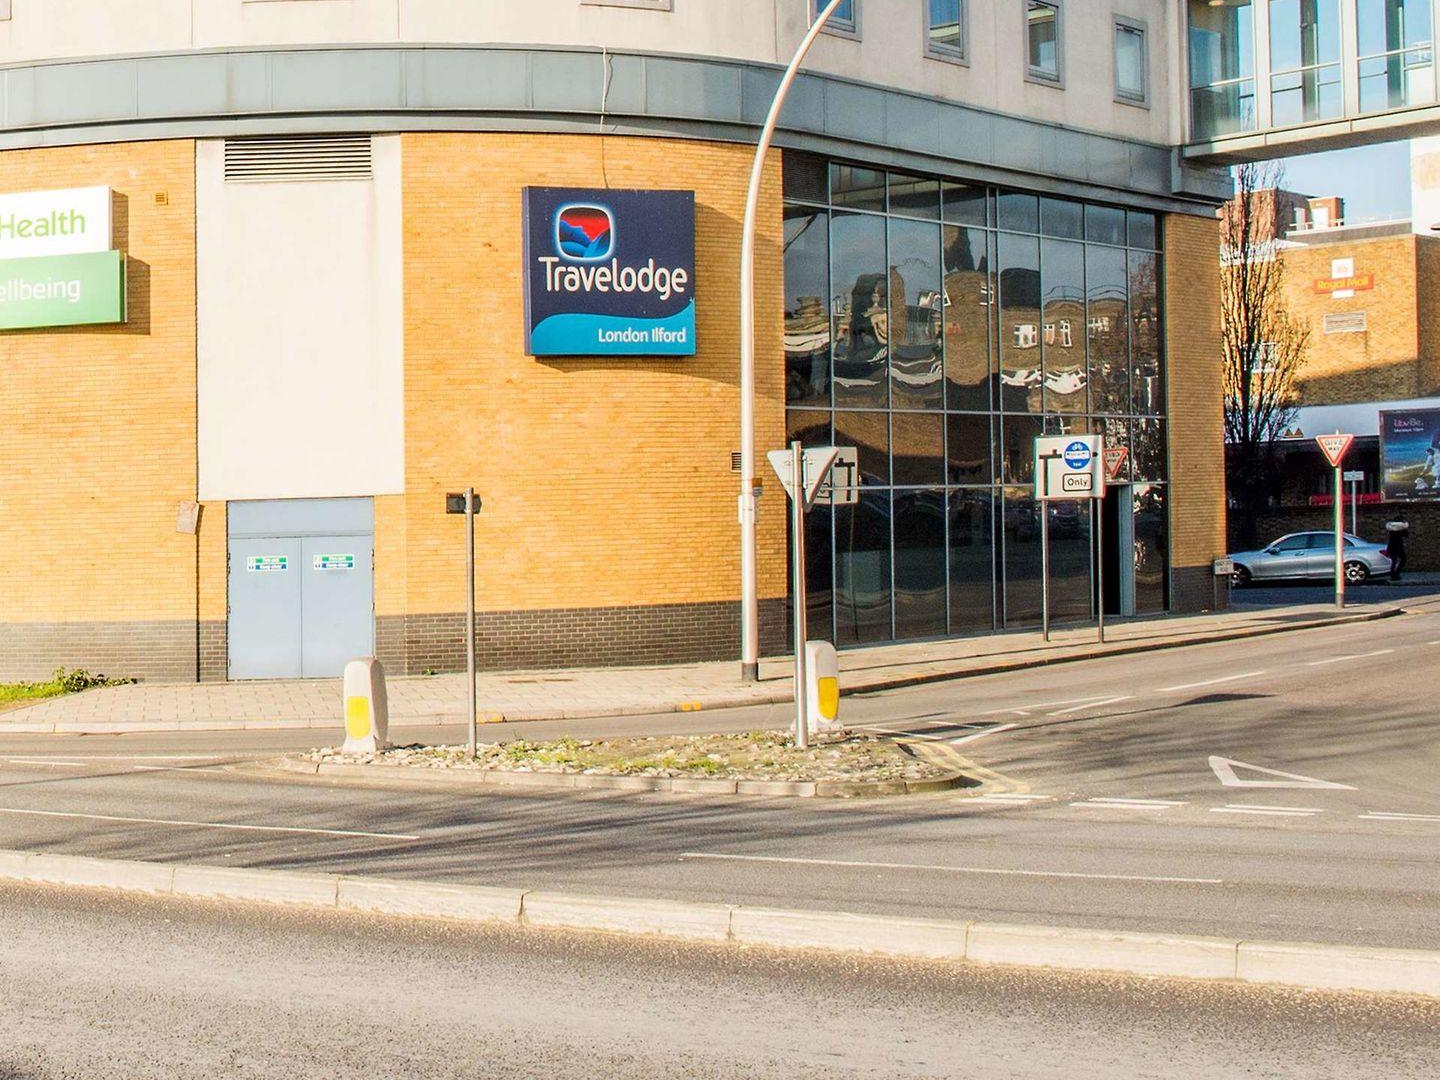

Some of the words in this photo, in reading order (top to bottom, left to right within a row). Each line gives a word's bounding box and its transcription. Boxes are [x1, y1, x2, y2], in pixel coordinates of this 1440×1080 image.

[538, 256, 688, 300] Travelodge
[1317, 279, 1346, 290] Royal
[1347, 276, 1369, 288] Mail
[598, 327, 649, 343] London
[652, 327, 686, 343] Ilford
[1067, 478, 1088, 487] Only
